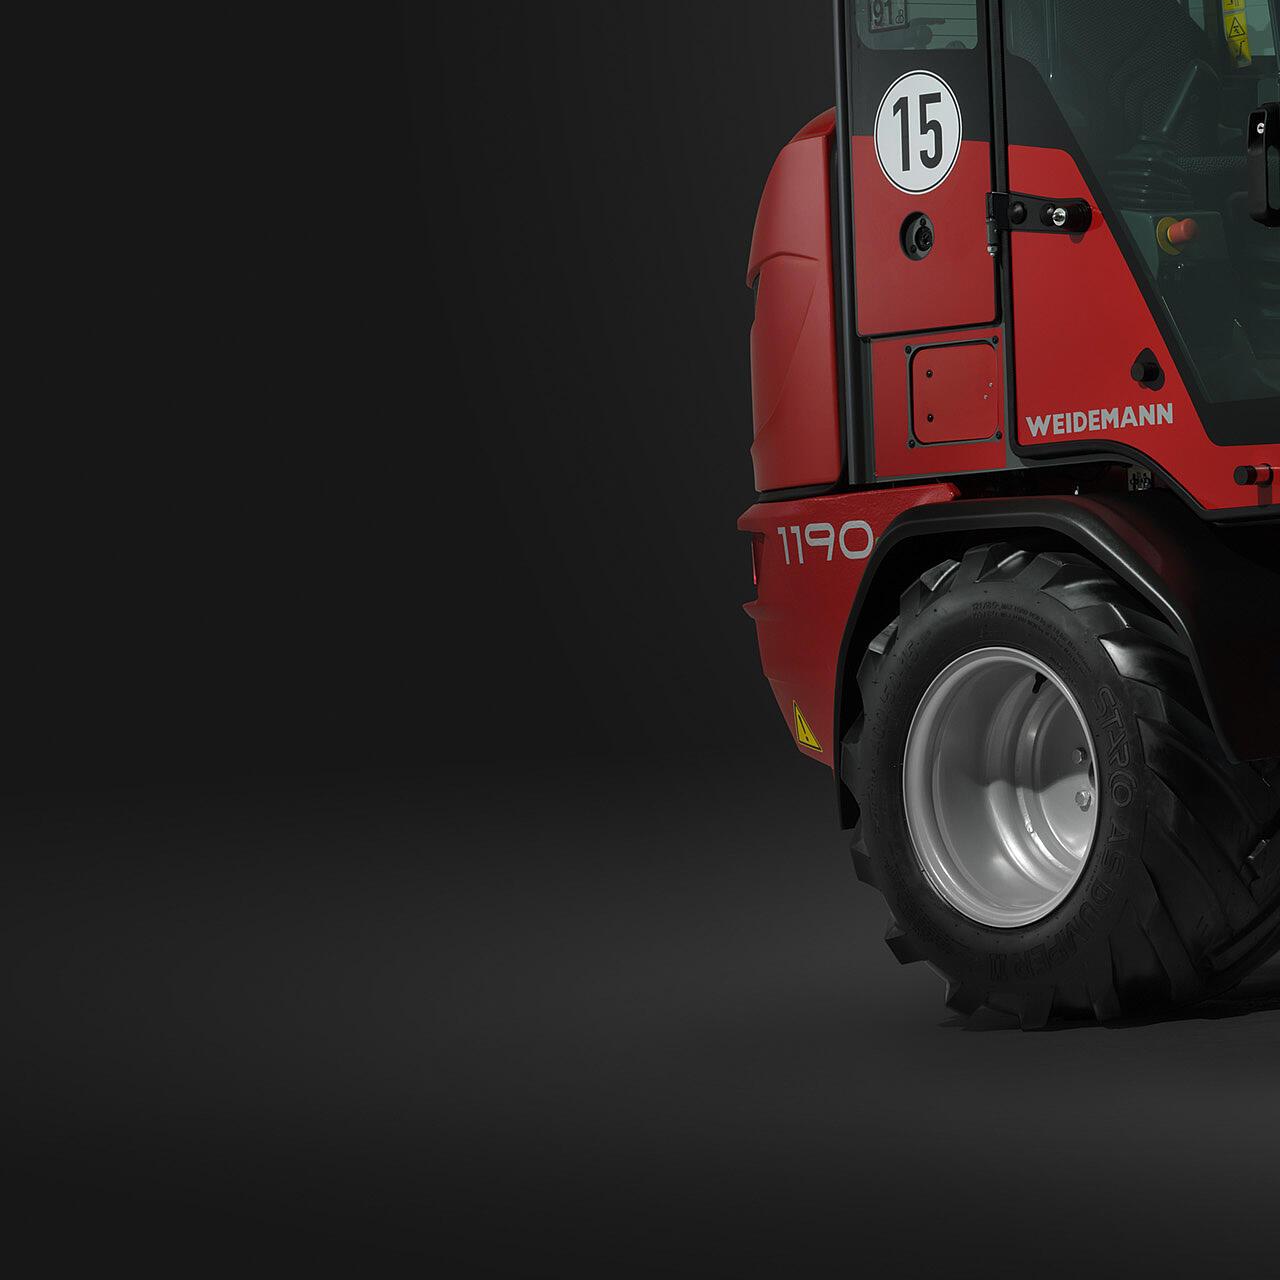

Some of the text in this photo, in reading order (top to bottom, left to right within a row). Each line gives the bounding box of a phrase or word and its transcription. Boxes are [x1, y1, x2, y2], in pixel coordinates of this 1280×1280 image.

[892, 92, 943, 172] 15
[1025, 402, 1174, 438] WEIDEMANN
[777, 519, 874, 566] 1190
